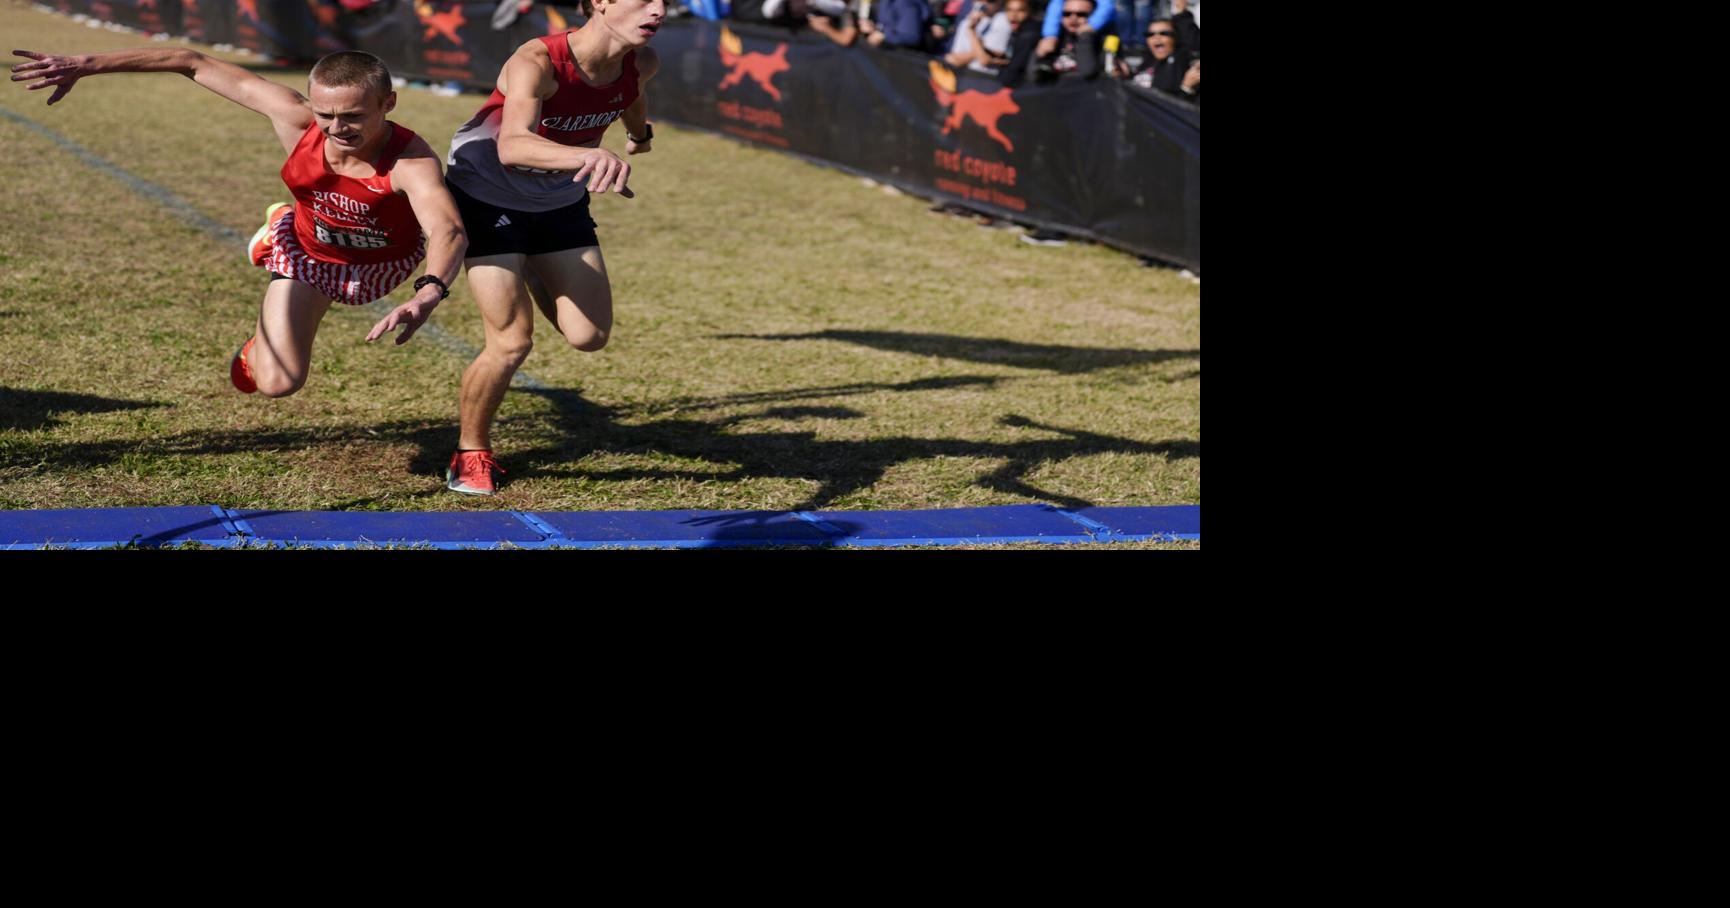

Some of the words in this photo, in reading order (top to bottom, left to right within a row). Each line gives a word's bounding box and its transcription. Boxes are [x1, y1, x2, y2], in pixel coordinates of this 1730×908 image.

[934, 149, 961, 172] red
[963, 156, 1017, 187] coyote
[312, 190, 370, 215] BISHOP
[315, 225, 387, 248] 8185
